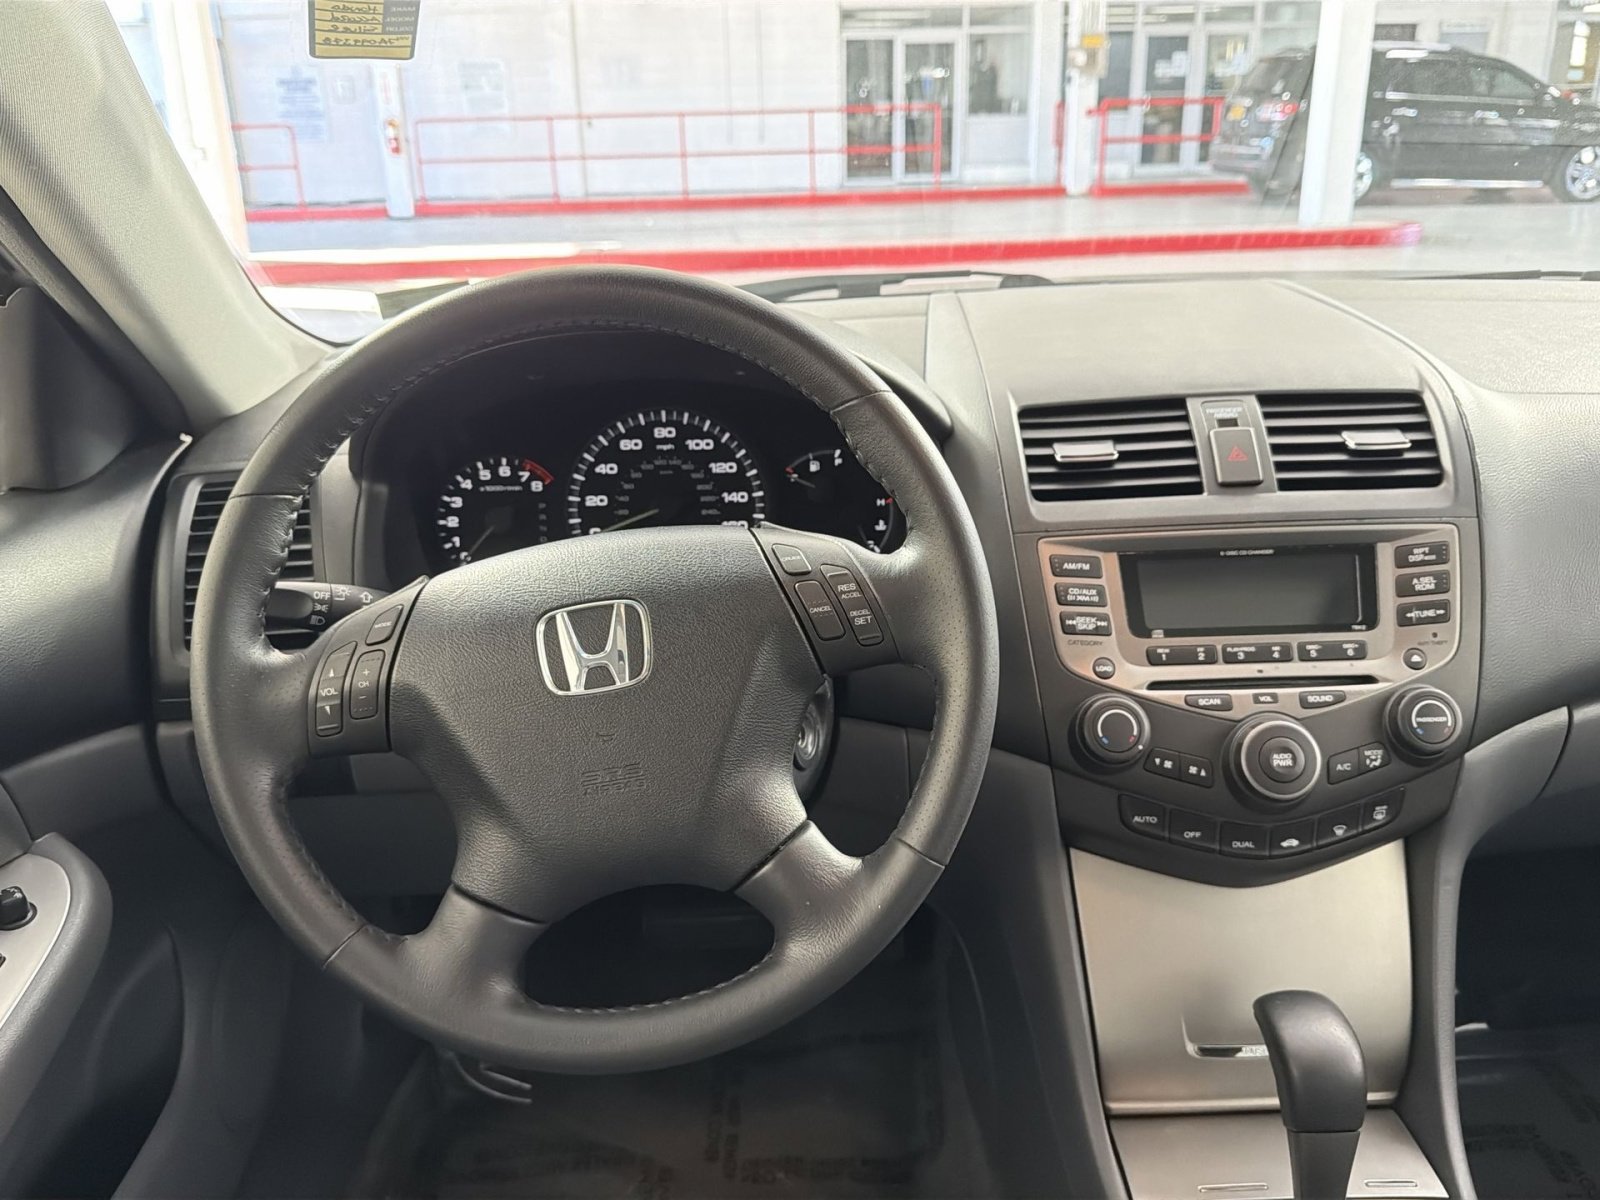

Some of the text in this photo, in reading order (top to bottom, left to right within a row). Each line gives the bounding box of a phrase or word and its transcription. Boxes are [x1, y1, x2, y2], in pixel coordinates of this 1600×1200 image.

[653, 427, 676, 438] 80
[619, 439, 643, 450] 60
[684, 439, 714, 451] 100
[498, 465, 512, 478] 6
[594, 463, 618, 475] 40
[708, 462, 738, 474] 120
[479, 469, 492, 481] 5
[518, 471, 531, 483] 7
[460, 479, 473, 491] 4
[530, 480, 544, 492] 8
[584, 495, 609, 507] 20
[721, 491, 749, 503] 140
[449, 496, 463, 509] 3
[876, 498, 886, 507] H
[446, 515, 460, 528] 2
[451, 535, 461, 548] 1
[1062, 562, 1090, 571] AM/FM
[837, 582, 857, 593] RES
[1068, 587, 1097, 596] CD/AUX
[313, 590, 331, 600] OFF
[841, 590, 863, 600] ACCEL
[809, 605, 832, 614] CANCEL
[849, 608, 871, 618] DECEL
[1415, 608, 1438, 618] TUNE
[854, 615, 873, 626] SET
[1075, 616, 1098, 624] SEEK
[1161, 653, 1167, 661] 1
[1198, 652, 1206, 661] 2
[1237, 651, 1245, 661] 3
[1272, 650, 1280, 659] 4
[1309, 649, 1318, 658] 5
[1346, 648, 1355, 657] 6
[358, 680, 369, 688] CH
[320, 686, 339, 696] VOL
[1197, 698, 1221, 706] SCAN
[1307, 694, 1334, 703] SOUND
[1273, 759, 1293, 767] PWR
[1336, 762, 1352, 771] A/C
[1133, 815, 1158, 824] AUTO
[1183, 830, 1202, 839] OFF
[1231, 840, 1255, 849] DUAL
